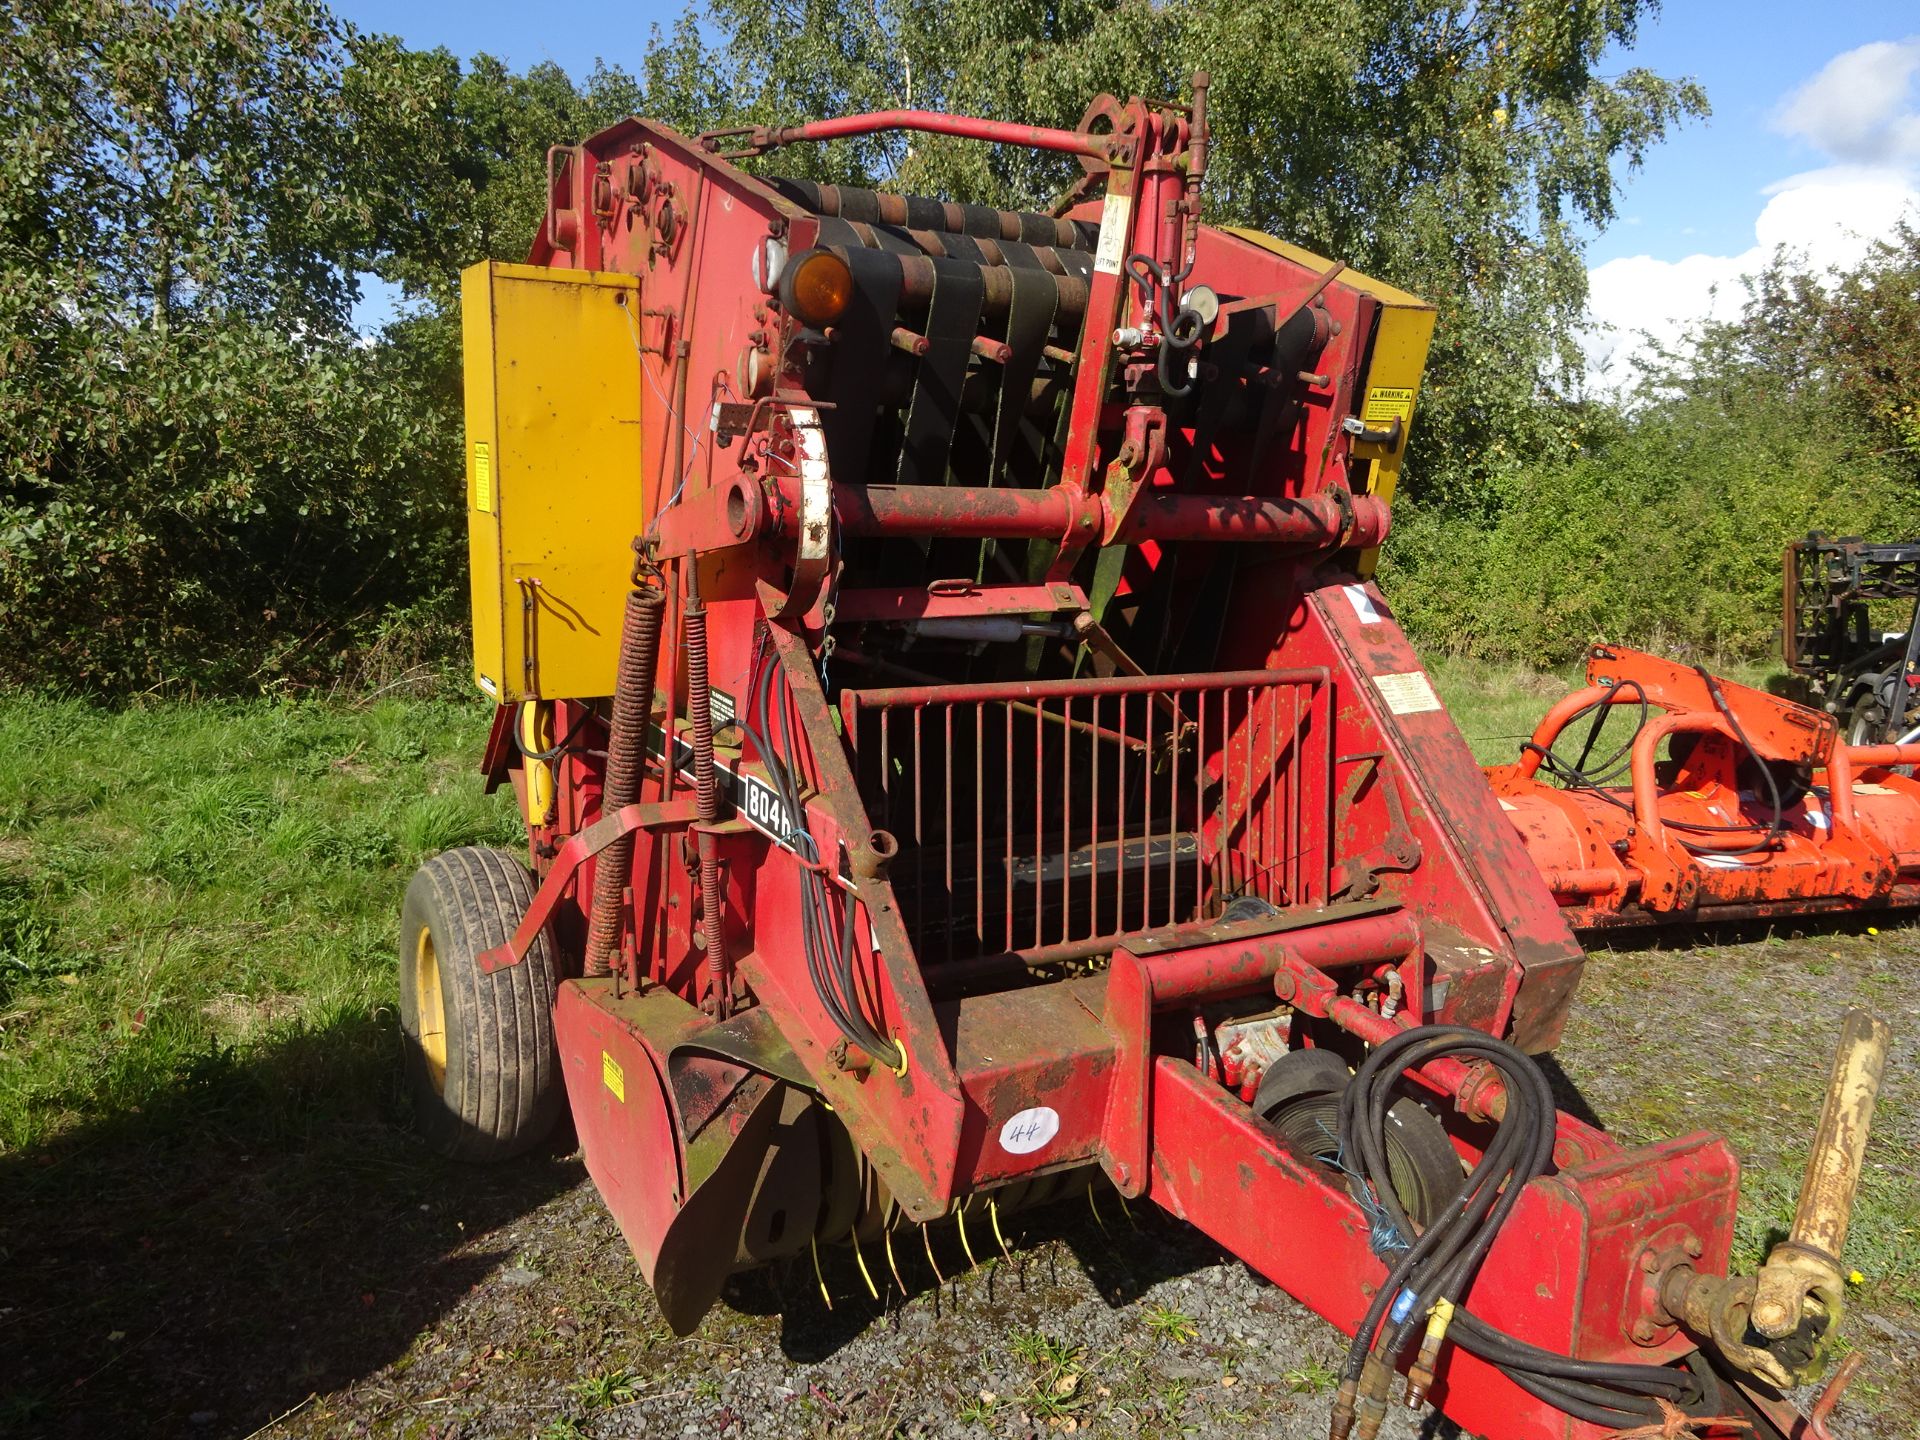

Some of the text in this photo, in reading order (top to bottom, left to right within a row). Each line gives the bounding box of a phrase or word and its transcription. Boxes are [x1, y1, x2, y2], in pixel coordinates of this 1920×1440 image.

[1106, 258, 1119, 269] POINT
[1380, 390, 1404, 399] WARNING
[1009, 1123, 1041, 1142] 44
